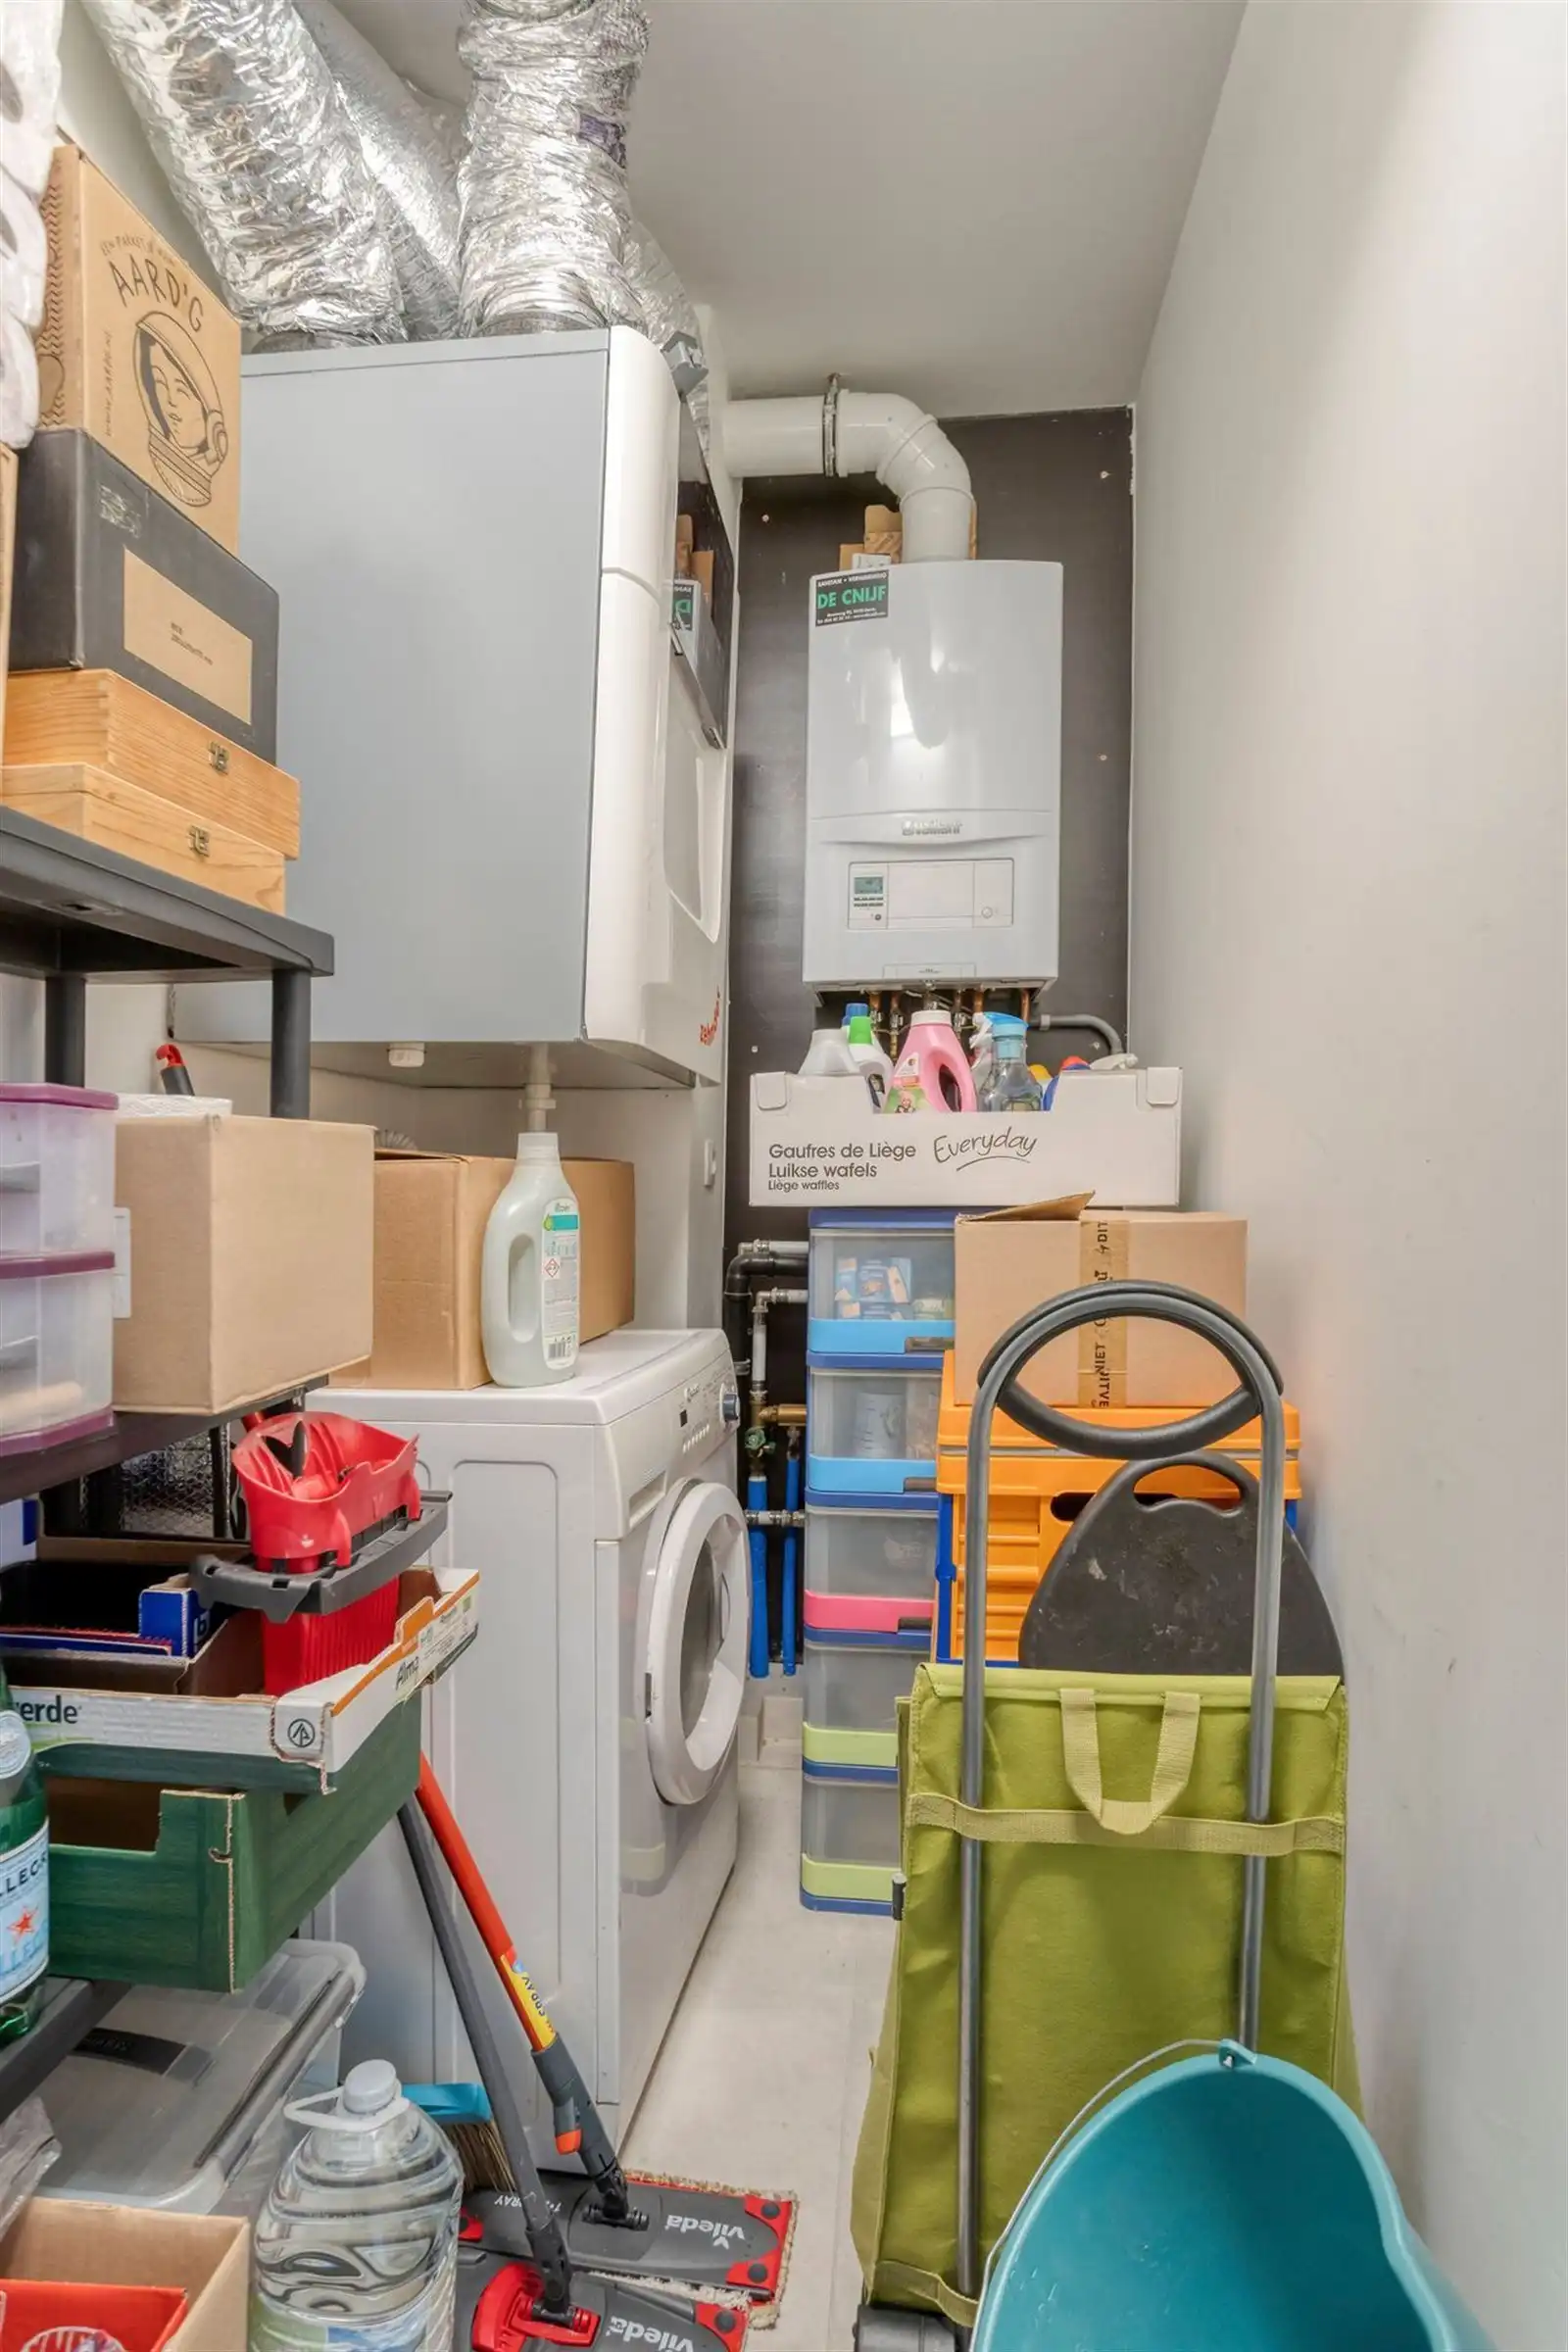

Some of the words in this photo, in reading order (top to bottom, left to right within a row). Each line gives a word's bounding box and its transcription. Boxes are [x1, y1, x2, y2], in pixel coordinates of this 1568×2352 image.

[817, 592, 837, 610] DE
[842, 585, 887, 605] CNIJF
[769, 1144, 836, 1158] Gaufres
[841, 1143, 863, 1158] de
[869, 1142, 916, 1161] Liège
[933, 1126, 1037, 1163] Everyday
[768, 1162, 819, 1178] Luikse
[823, 1162, 877, 1178] wafels
[768, 1179, 799, 1193] Liège
[802, 1180, 840, 1191] waffles
[16, 1694, 78, 1724] erde
[666, 2214, 746, 2247] vileda
[610, 2315, 697, 2352] vileda
